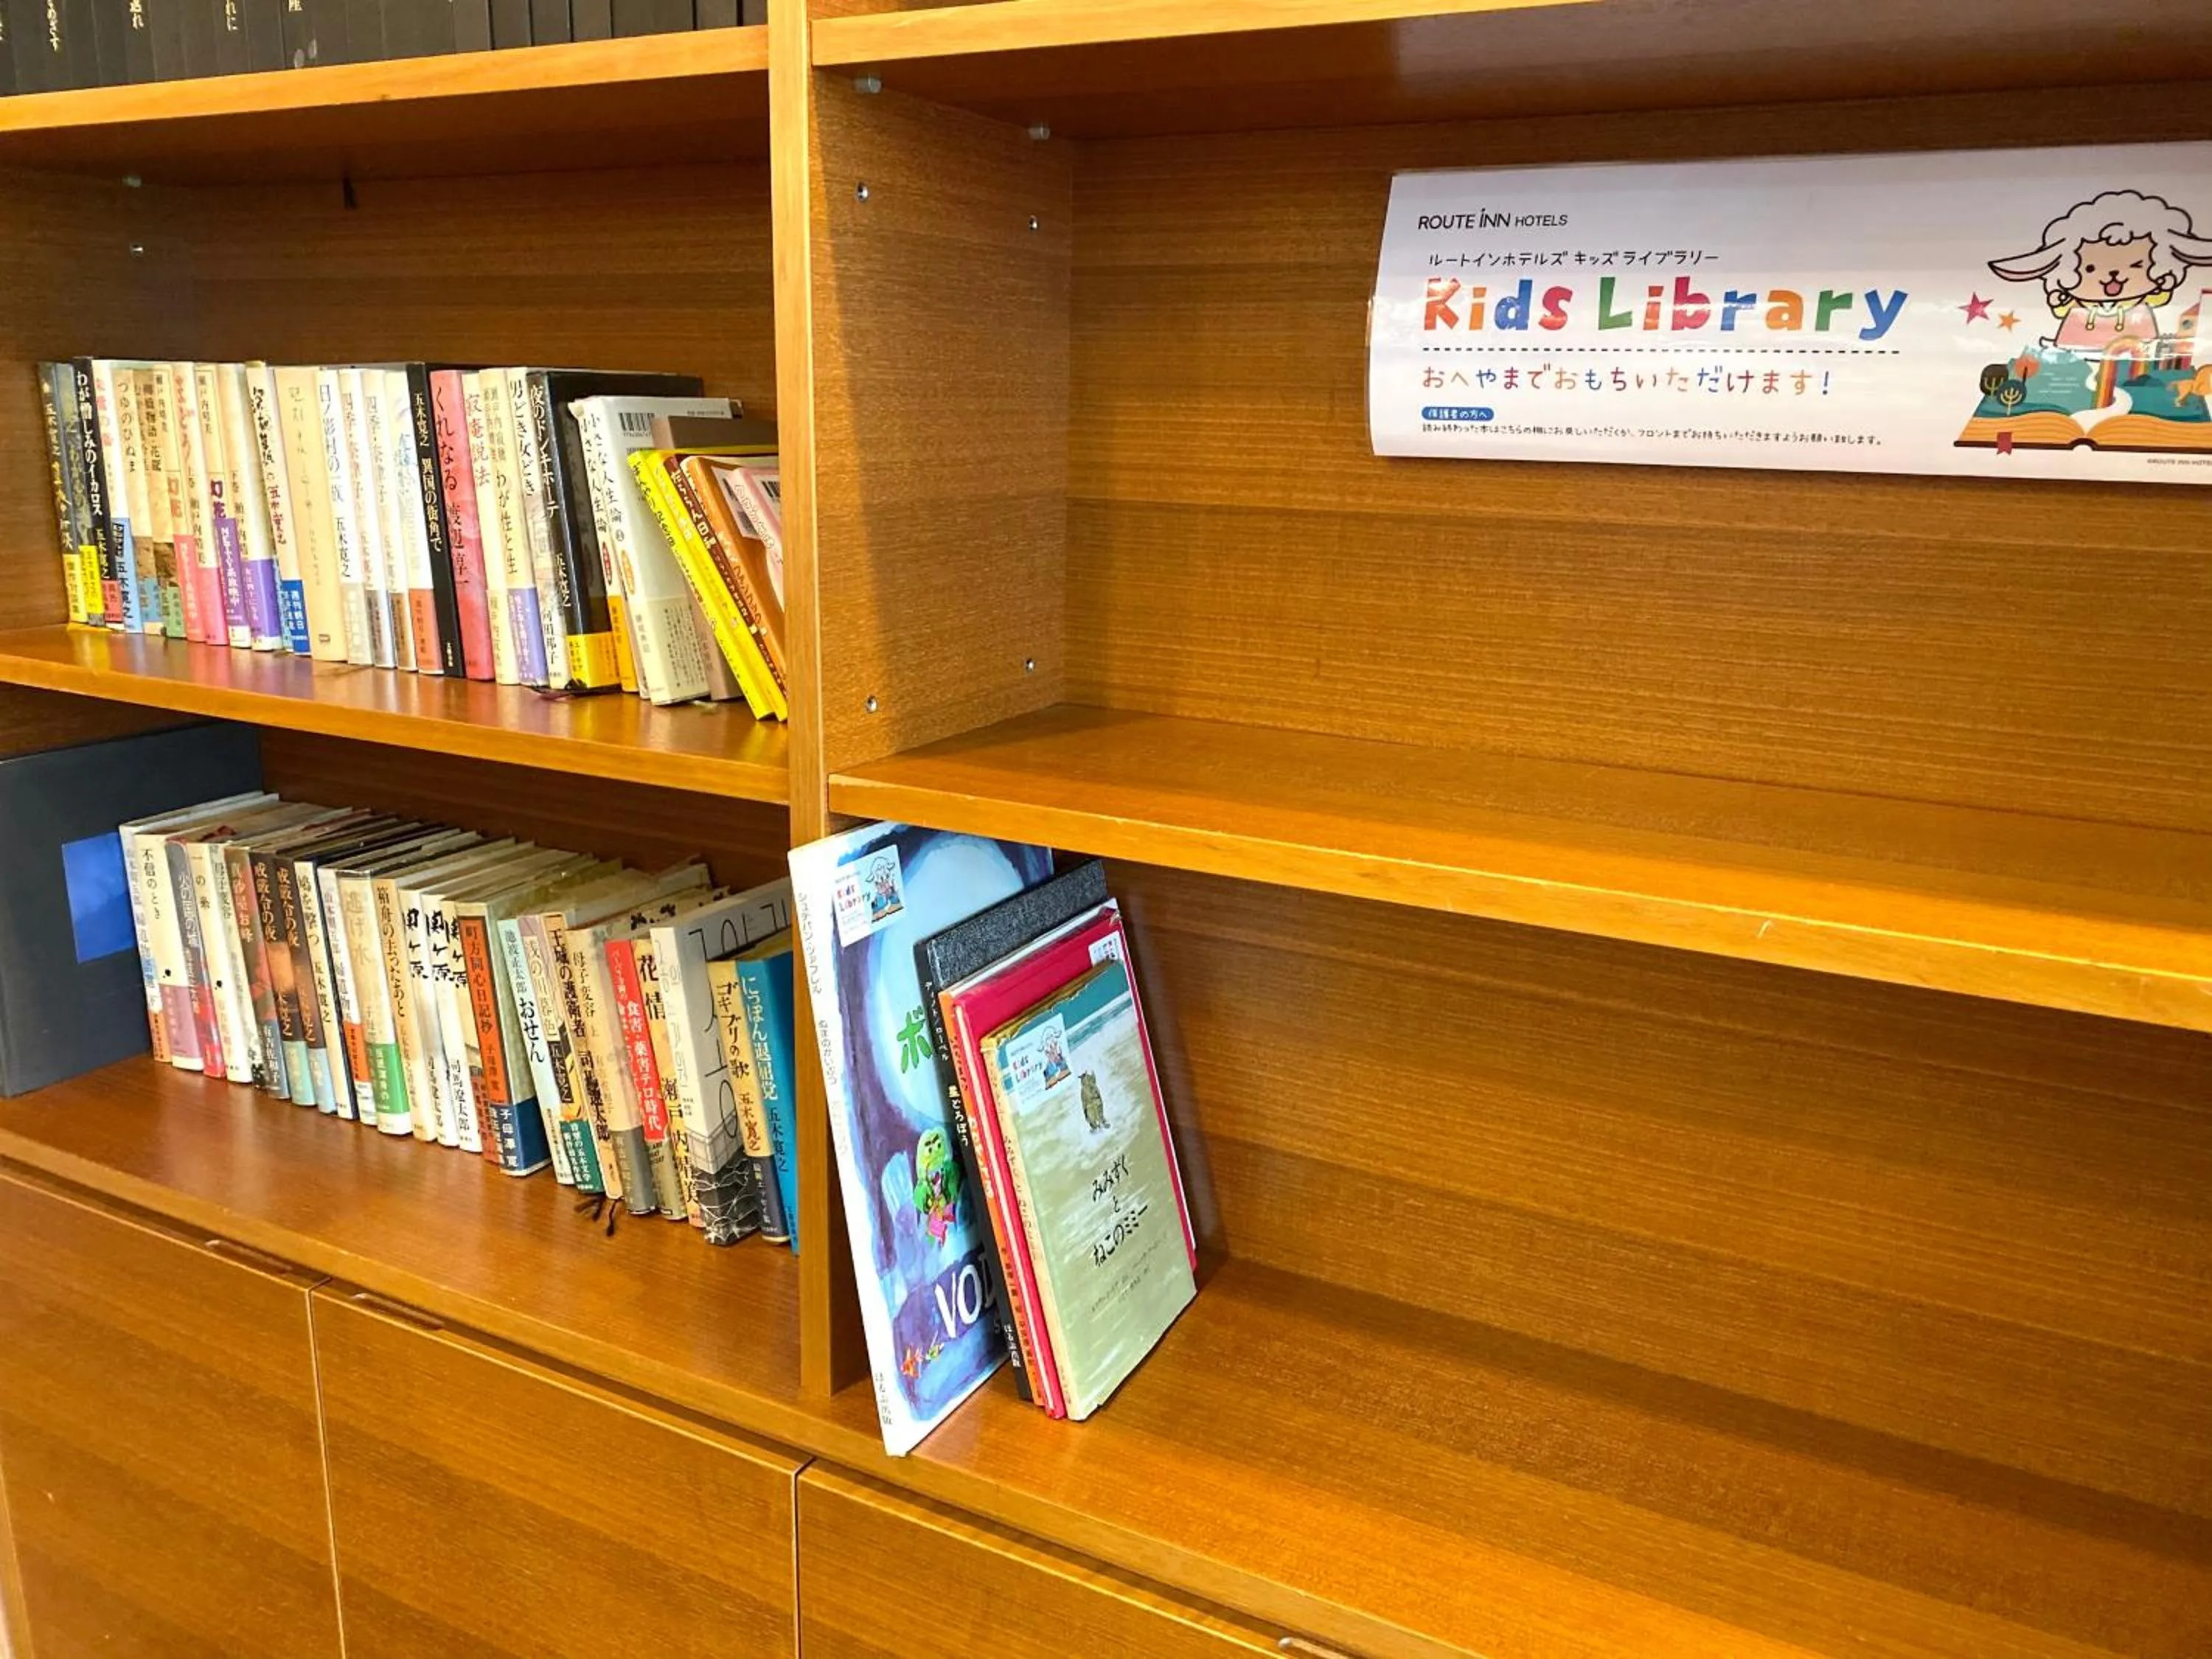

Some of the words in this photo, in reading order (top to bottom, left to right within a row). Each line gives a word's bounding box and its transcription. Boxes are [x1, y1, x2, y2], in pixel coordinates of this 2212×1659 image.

[1419, 214, 1475, 229] ROUTE
[1515, 214, 1568, 227] HOTELS
[1429, 250, 1568, 266] ルートインホテルズ
[1573, 250, 1619, 265] キッズ
[1623, 250, 1719, 265] ライブラリー
[1423, 276, 1573, 332] Kids
[1597, 276, 1909, 341] Library
[1422, 361, 1831, 397] おへやまでおもちいただけます！
[77, 371, 102, 515] わが憎しみのイカロス
[117, 382, 136, 473] つゆのひぬま
[414, 392, 431, 447] 五木寛之
[1427, 408, 1488, 420] 保護者の方へ
[319, 384, 343, 502] 日ノ影村の一族
[336, 517, 351, 578] 五木寛之
[530, 384, 560, 518] 夜のドンキホーテ
[555, 552, 571, 608] 五木寛之
[580, 418, 607, 533] 小さな人生論
[590, 412, 622, 523] 小さな人生論
[421, 457, 442, 552] 異国の街角で
[191, 855, 210, 910] 一の糸
[314, 961, 331, 1023] 五木寛之
[639, 954, 667, 1020] 花情
[518, 998, 545, 1063] おせん
[717, 981, 750, 1079] ゴキブリの歌
[738, 1093, 761, 1152] 五木寛之
[769, 1107, 790, 1173] 五木寛之
[1091, 1153, 1129, 1203] みみずく
[1113, 1195, 1121, 1213] と
